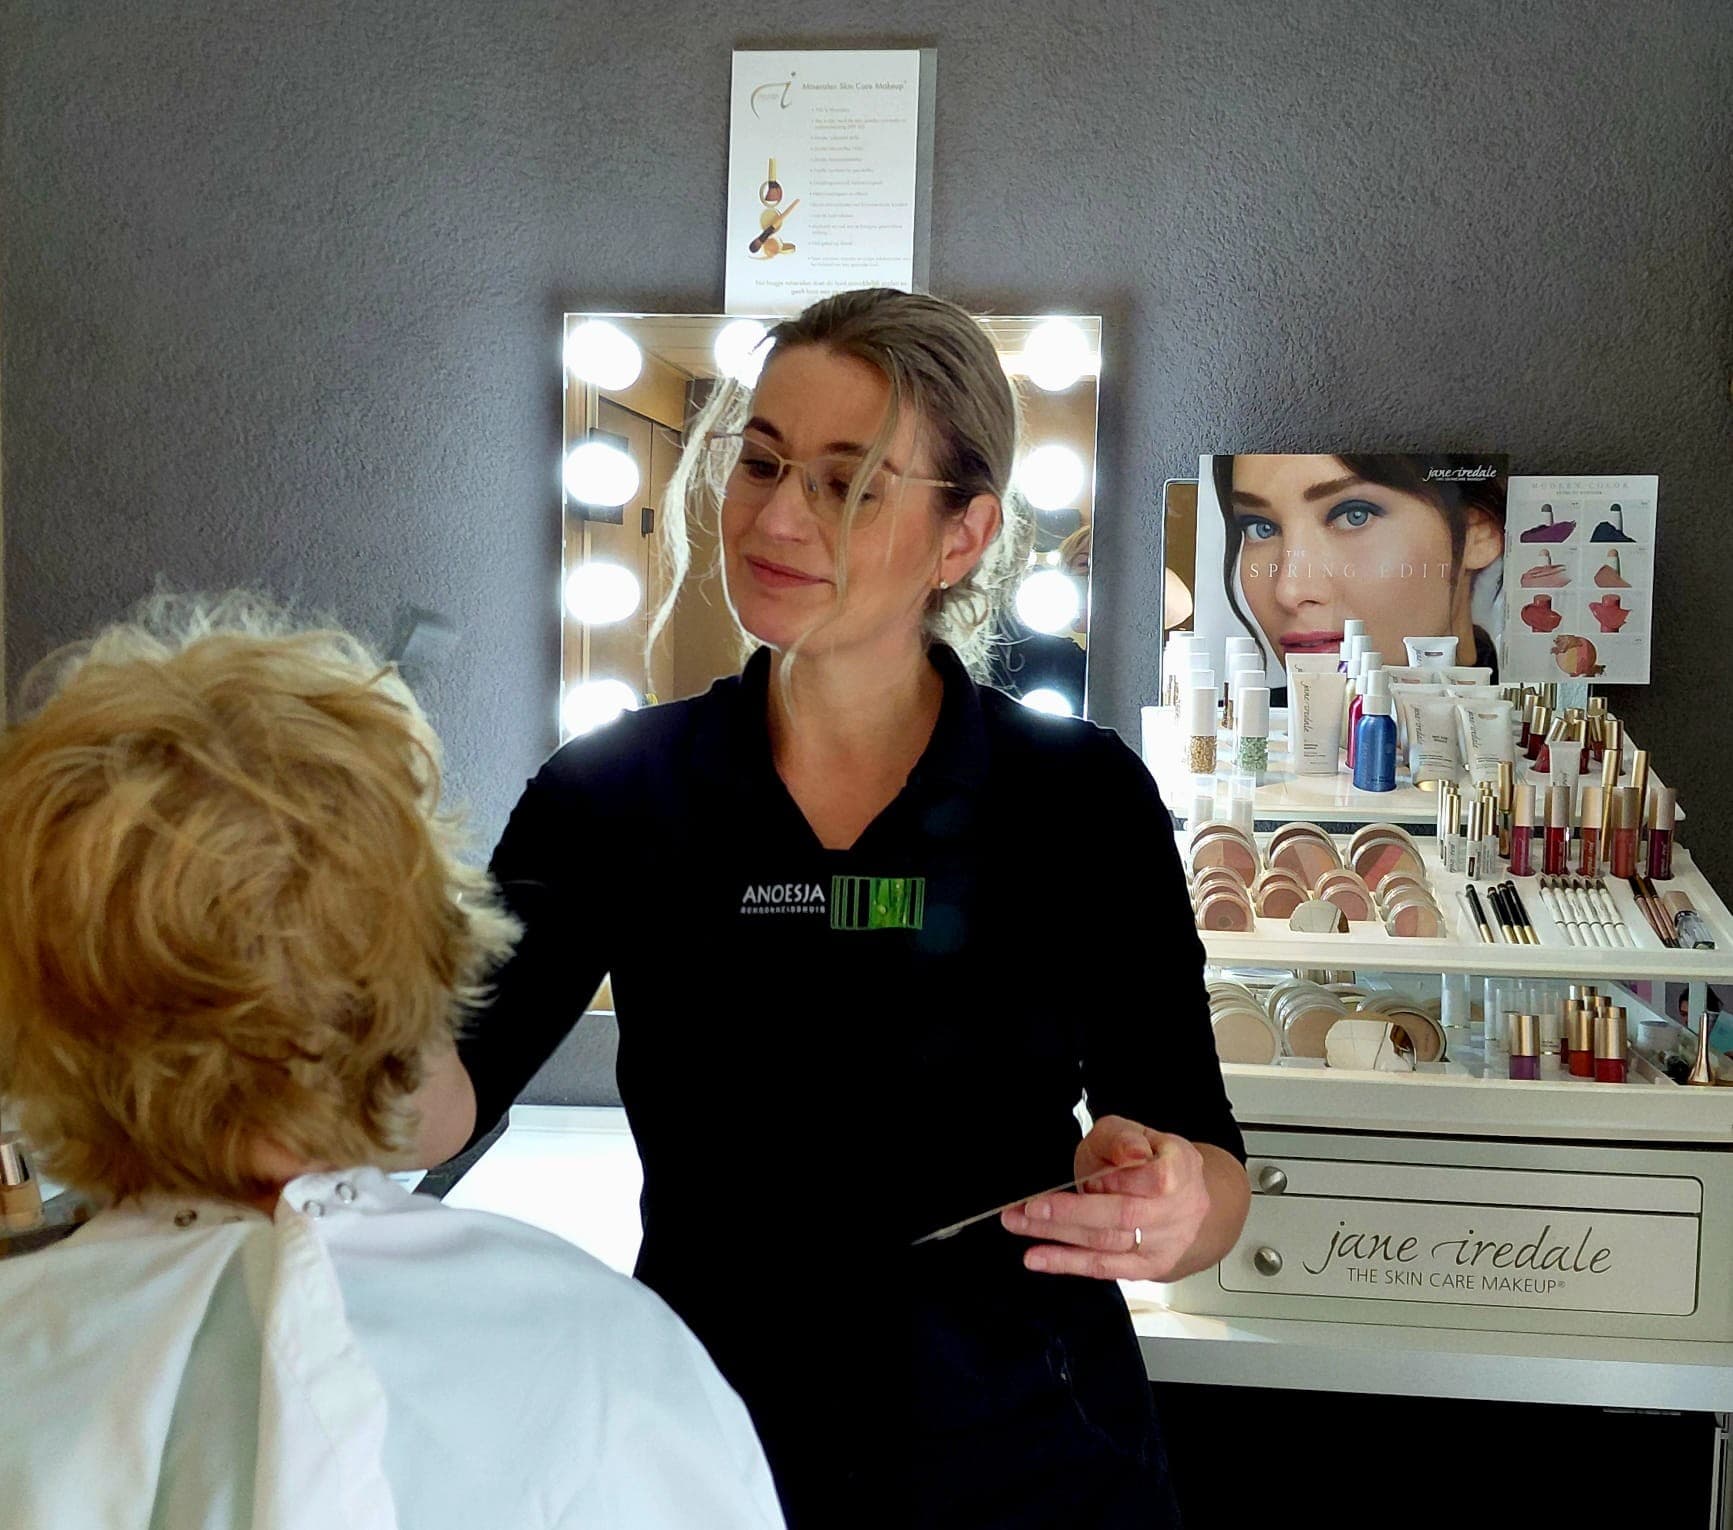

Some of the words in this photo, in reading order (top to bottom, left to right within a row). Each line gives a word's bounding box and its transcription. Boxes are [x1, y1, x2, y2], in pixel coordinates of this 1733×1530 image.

[855, 81, 873, 90] Care
[1422, 466, 1451, 482] jane
[1452, 464, 1497, 478] iredale
[1286, 550, 1306, 558] THE
[1249, 563, 1356, 578] SPRING
[1380, 563, 1449, 578] EDIT
[742, 883, 826, 904] ANOESJA
[1302, 1221, 1418, 1275] jane
[1431, 1225, 1612, 1274] iredale
[1347, 1267, 1378, 1284] THE
[1385, 1269, 1422, 1286] SKIN
[1429, 1273, 1475, 1290] CARE
